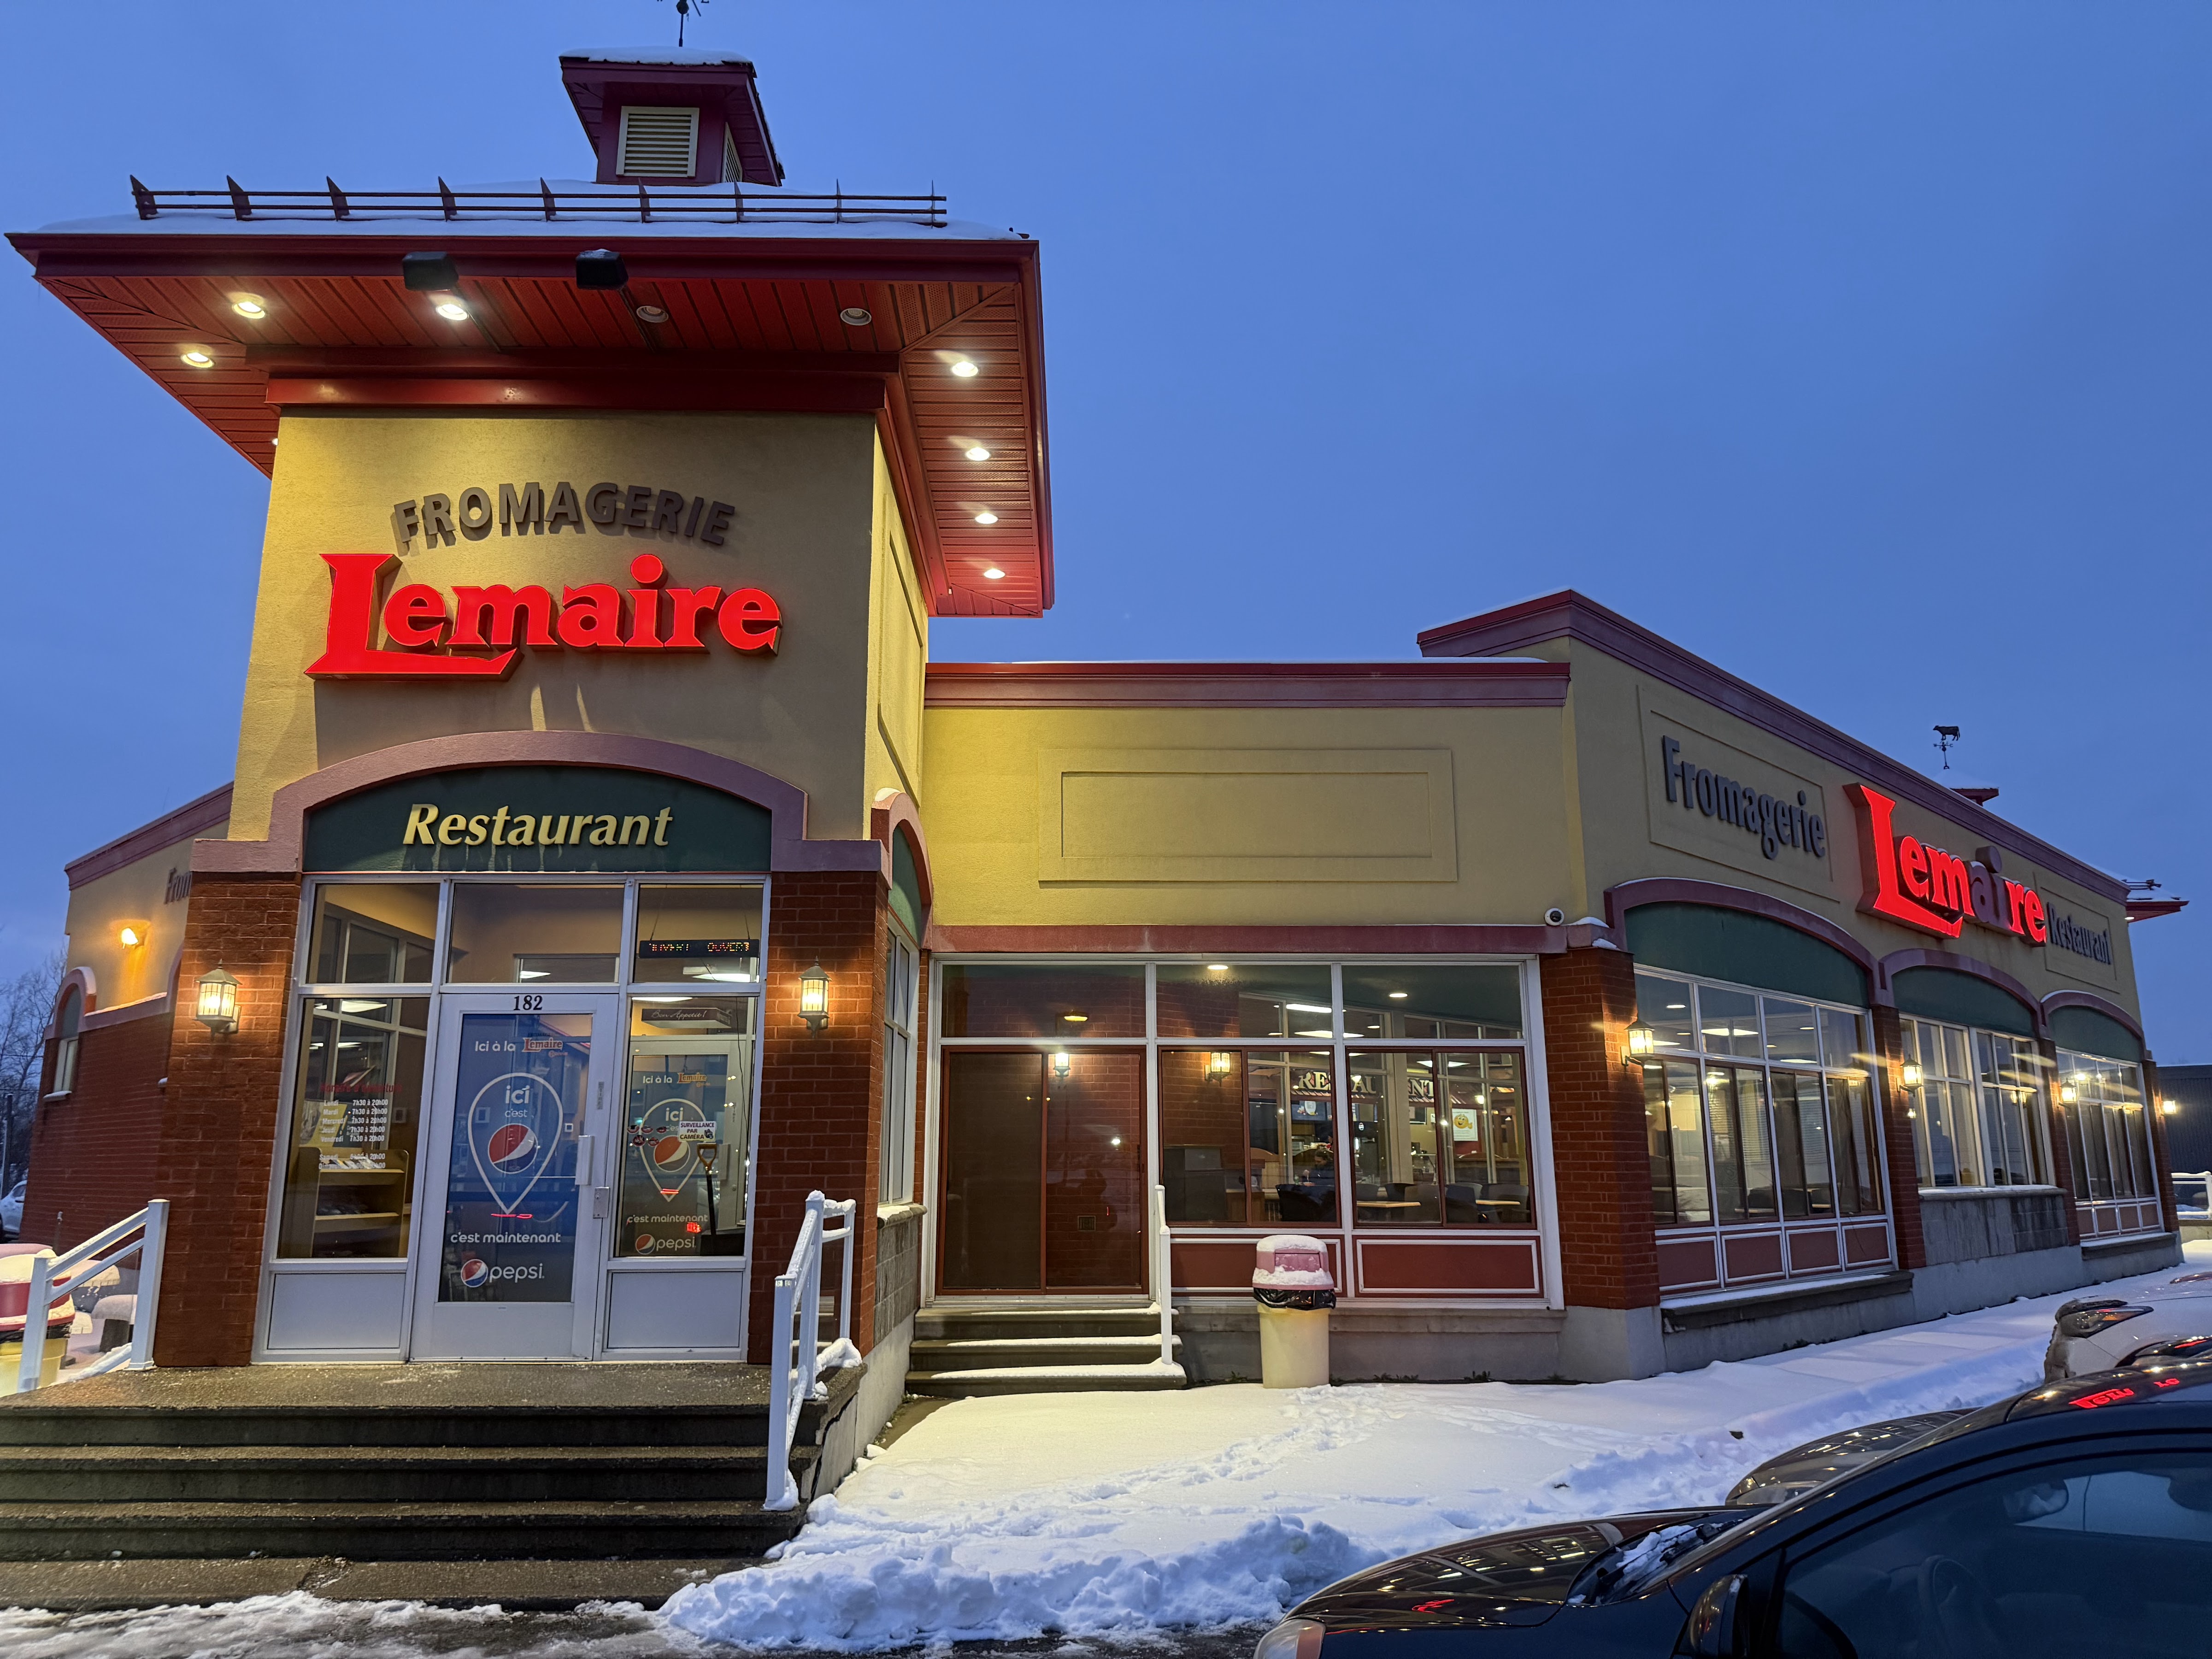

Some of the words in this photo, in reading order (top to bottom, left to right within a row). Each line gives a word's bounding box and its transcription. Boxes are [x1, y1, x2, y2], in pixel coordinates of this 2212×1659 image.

[394, 482, 735, 546] FROMAGERIE
[304, 553, 782, 679] Lemaire
[1662, 735, 1825, 860] Fromagerie
[402, 803, 673, 847] Restaurant
[1853, 782, 2047, 947] Lemaire
[2046, 901, 2112, 965] Restaurant
[513, 995, 543, 1011] 182
[475, 1041, 489, 1052] Ici
[492, 1041, 500, 1051] à
[504, 1041, 516, 1052] la
[522, 1037, 563, 1052] Lemaire
[643, 1075, 653, 1083] Ici
[677, 1072, 707, 1083] Lemaire
[505, 1085, 530, 1104] ici
[505, 1108, 528, 1118] c'est
[665, 1107, 683, 1121] ici
[627, 1214, 649, 1223] c'est
[450, 1231, 480, 1243] c'est
[482, 1232, 561, 1243] maintenant
[656, 1236, 695, 1251] pepsi
[489, 1263, 543, 1283] pepsi
